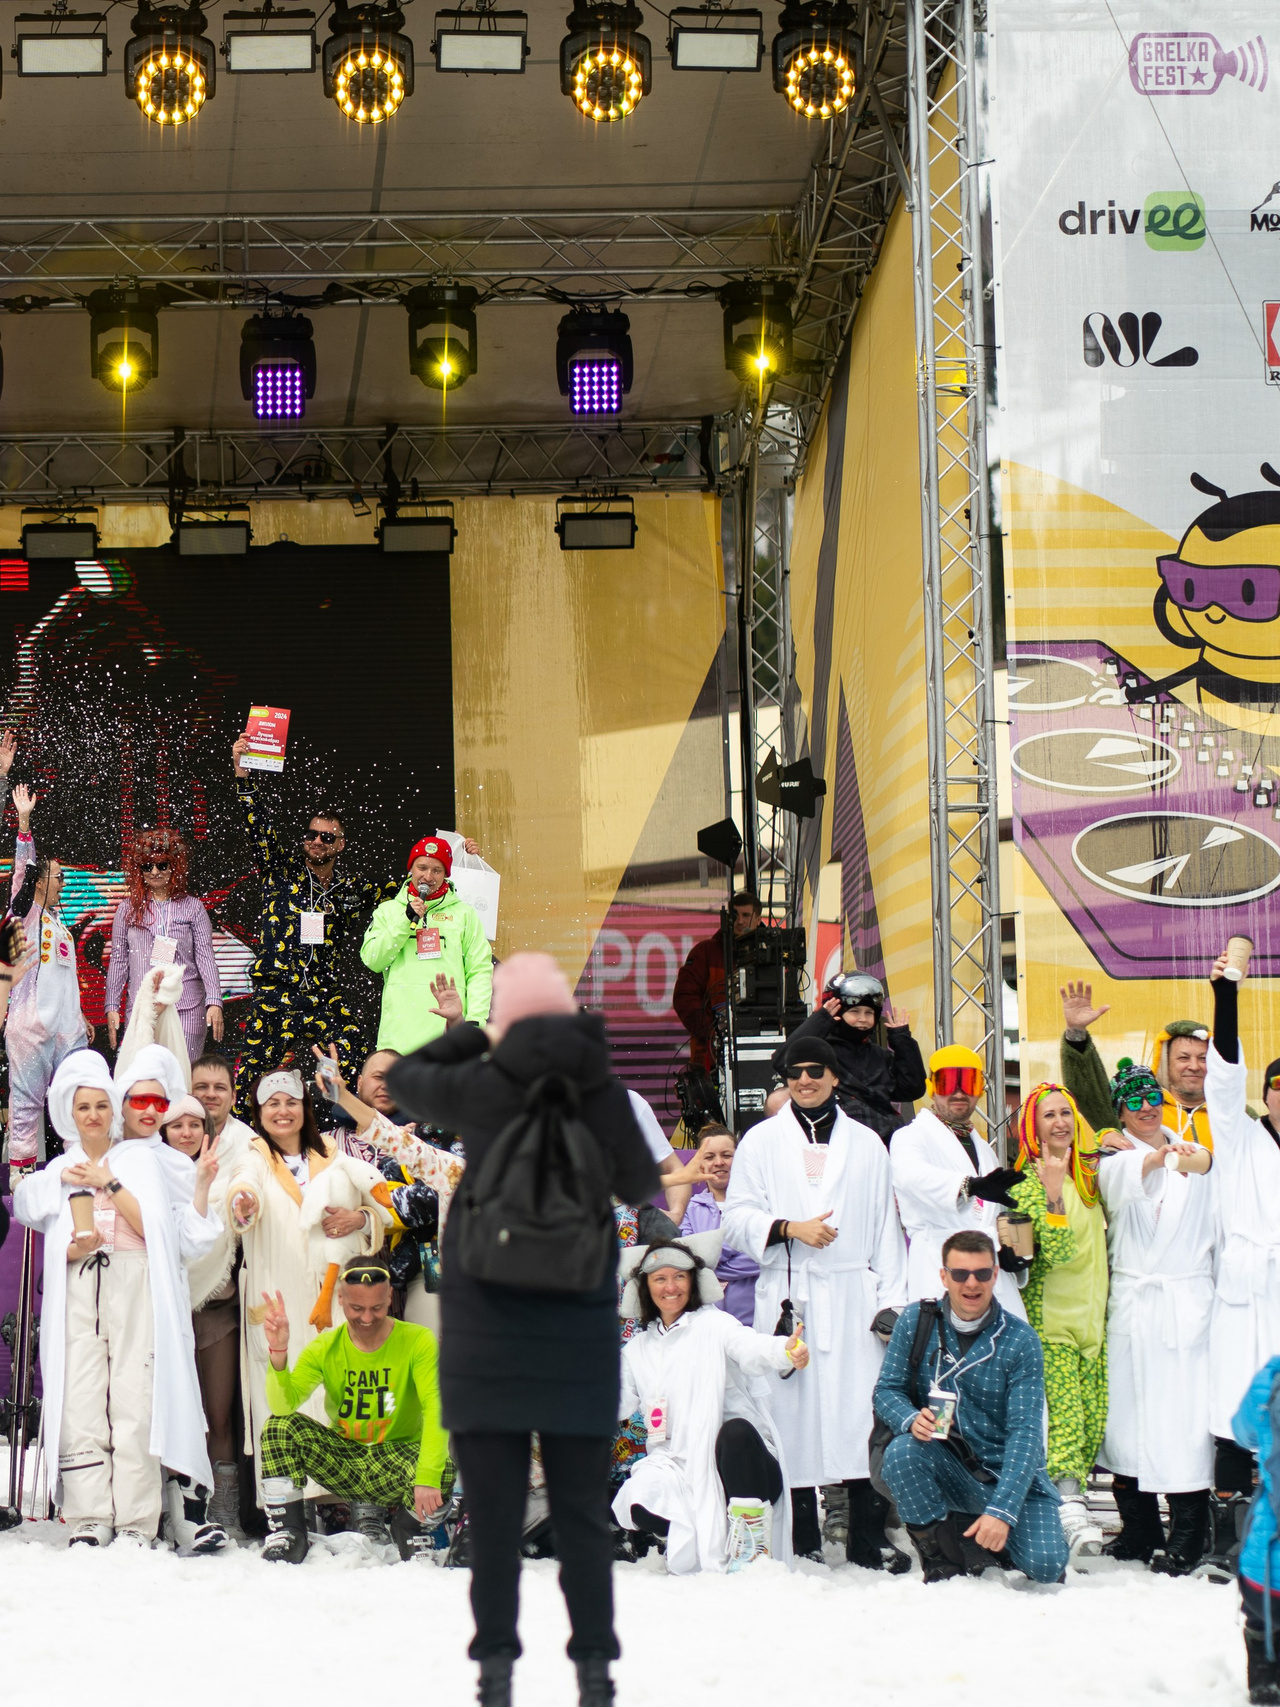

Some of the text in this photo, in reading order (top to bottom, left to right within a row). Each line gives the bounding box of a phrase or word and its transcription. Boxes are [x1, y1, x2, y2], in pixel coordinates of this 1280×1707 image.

[1142, 41, 1209, 62] GRELKA
[1144, 67, 1185, 86] FEST
[1058, 200, 1206, 241] drivee
